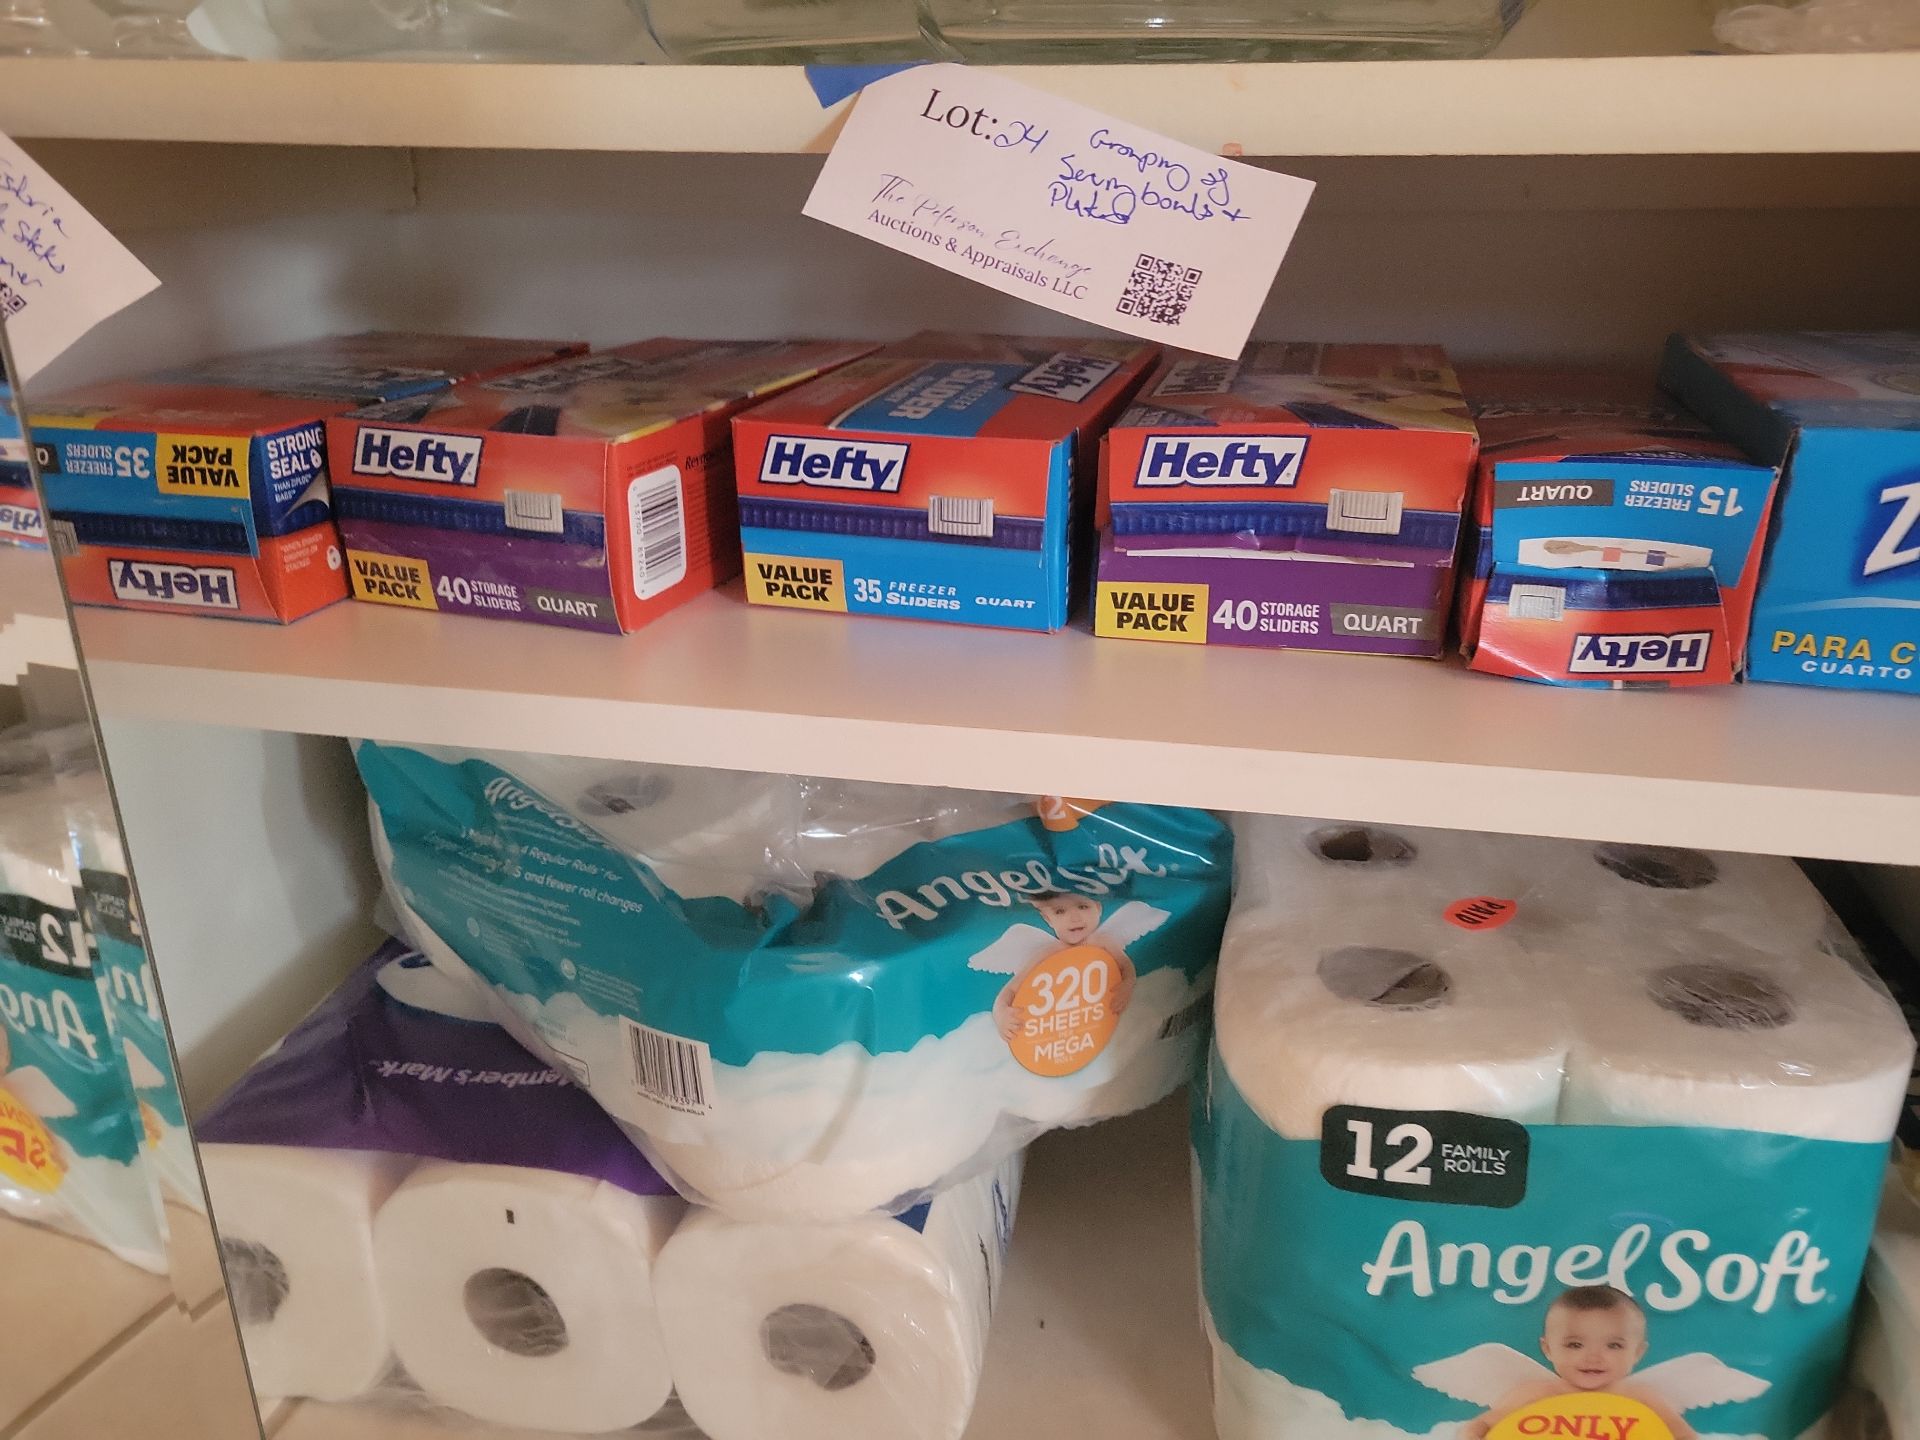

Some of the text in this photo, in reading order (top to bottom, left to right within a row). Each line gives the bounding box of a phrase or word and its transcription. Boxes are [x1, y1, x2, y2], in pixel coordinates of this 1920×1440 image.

[920, 88, 998, 140] Lot:
[872, 173, 914, 203] The
[994, 229, 1093, 279] Exchange
[867, 208, 1089, 300] Auctions & Appraisals LLC
[66, 443, 113, 459] SLIDERS
[172, 443, 233, 466] PACK
[266, 427, 324, 460] STRONG
[66, 459, 114, 477] FREEZER
[115, 446, 151, 479] 35
[269, 452, 311, 480] SEAL
[361, 433, 475, 483] Hefty
[769, 441, 900, 491] Hefty
[1146, 441, 1297, 486] Hefty
[166, 465, 241, 488] VALUE
[1629, 479, 1695, 496] SLIDERS
[1516, 485, 1593, 502] QUART
[1624, 494, 1692, 513] FREEZER
[1698, 485, 1744, 517] 15
[118, 560, 228, 604] Hefty
[354, 558, 422, 584] VALUE
[757, 562, 833, 585] VALUE
[365, 579, 422, 601] PACK
[436, 575, 472, 606] 40
[471, 580, 518, 599] STORAGE
[765, 582, 830, 602] PACK
[853, 578, 882, 604] 35
[885, 591, 961, 611] SLIDERS
[889, 581, 957, 597] FREEZER
[474, 595, 522, 613] SLIDERS
[537, 595, 600, 619] QUART
[975, 596, 1036, 609] QUART
[1110, 591, 1196, 613] VALUE
[1260, 601, 1320, 619] STORAGE
[1116, 611, 1188, 633] PACK
[1212, 599, 1258, 631] 40
[1259, 618, 1319, 635] SLIDERS
[1343, 613, 1423, 635] QUART
[1578, 636, 1710, 669] Hefty
[1772, 630, 1872, 662] PARA
[1800, 660, 1912, 681] CUARTO
[529, 847, 572, 867] Regular
[524, 872, 645, 914] and fewer roll changes
[876, 859, 1066, 931] Angel
[1454, 899, 1506, 925] PAID
[1027, 959, 1109, 1017] 320
[1024, 1002, 1105, 1037] SHEETS
[1034, 1032, 1095, 1062] MEGA
[376, 1059, 453, 1083] Mark
[1344, 1119, 1433, 1186] 12
[1441, 1143, 1511, 1164] FAMILY
[1443, 1157, 1506, 1177] ROLLS
[1362, 1219, 1830, 1314] Angel Soft
[1517, 1415, 1640, 1440] ONLY
